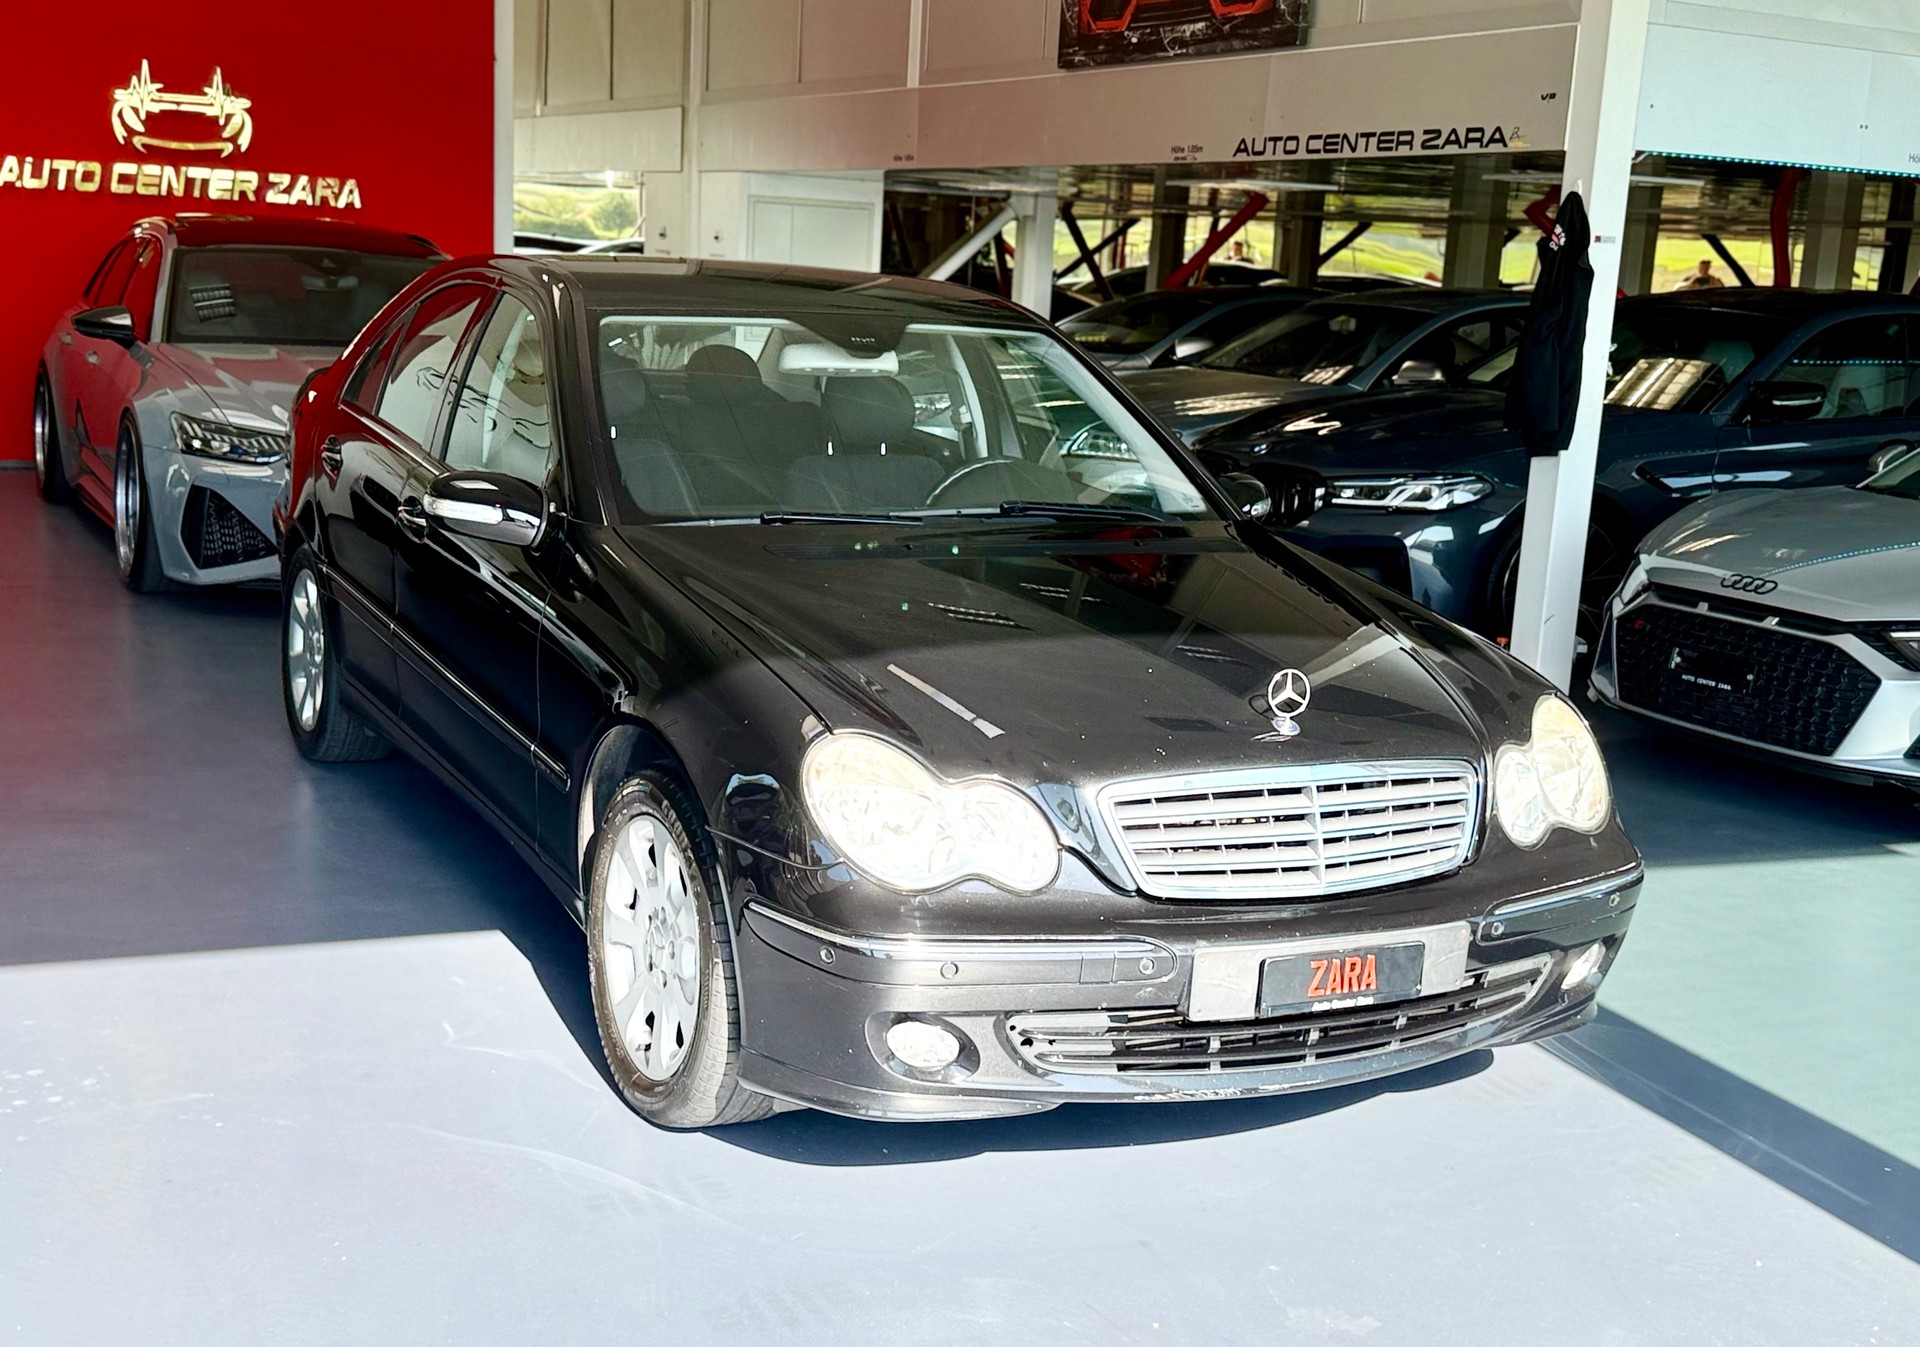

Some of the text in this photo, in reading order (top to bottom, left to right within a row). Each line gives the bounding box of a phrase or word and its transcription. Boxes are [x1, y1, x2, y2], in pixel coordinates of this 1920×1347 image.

[1233, 136, 1300, 157] AUTO
[1305, 131, 1415, 154] CENTER
[1420, 126, 1508, 149] ZARA
[0, 155, 362, 209] AUTO CENTER ZARA
[1681, 674, 1695, 682] AUTO
[1696, 677, 1716, 687] CENTER
[1308, 954, 1376, 996] ZARA
